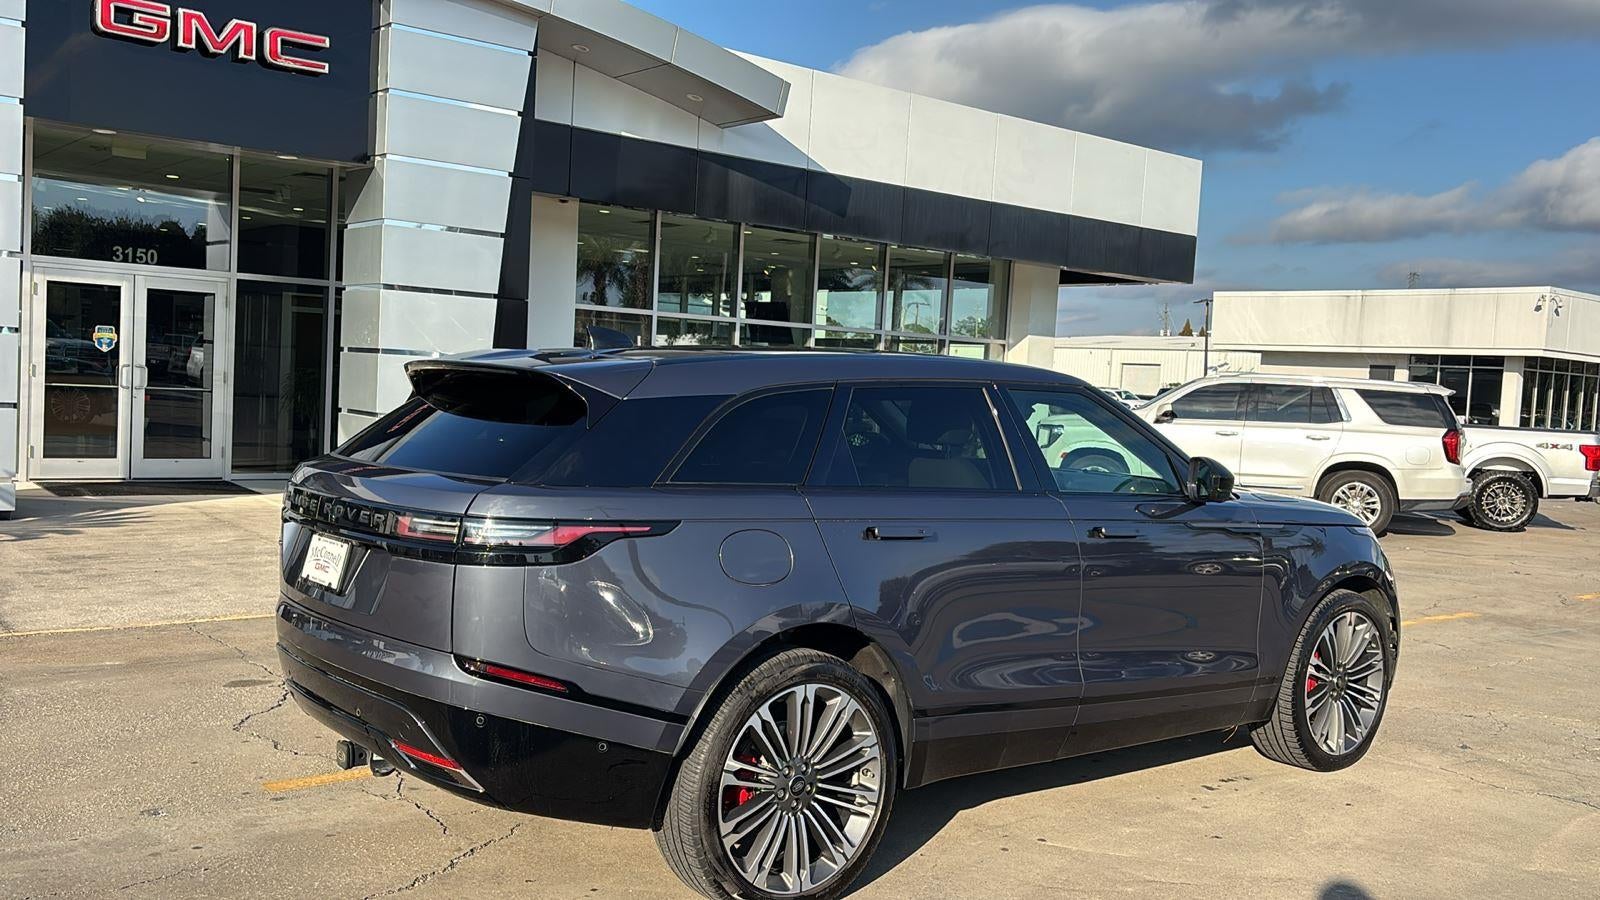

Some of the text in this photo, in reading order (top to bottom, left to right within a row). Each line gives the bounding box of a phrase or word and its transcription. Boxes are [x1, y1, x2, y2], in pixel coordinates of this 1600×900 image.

[94, 0, 330, 74] GMC
[112, 245, 158, 265] 3150
[323, 502, 386, 527] ROVER
[314, 562, 331, 575] GMC
